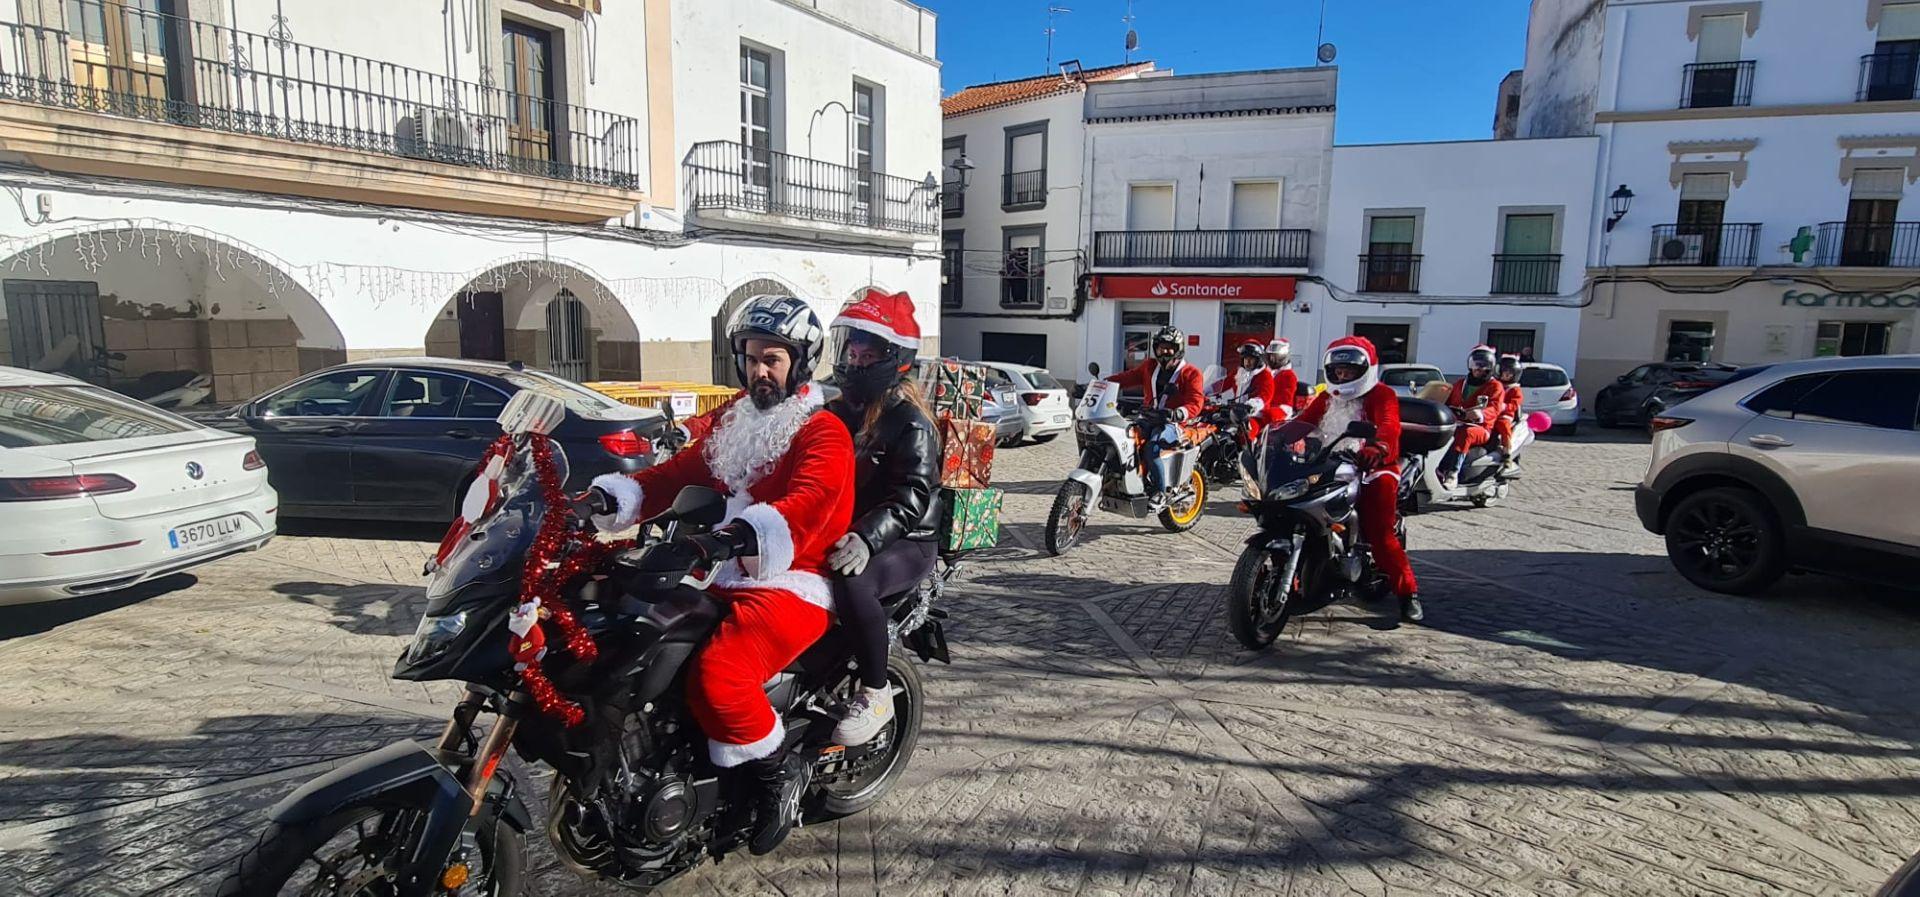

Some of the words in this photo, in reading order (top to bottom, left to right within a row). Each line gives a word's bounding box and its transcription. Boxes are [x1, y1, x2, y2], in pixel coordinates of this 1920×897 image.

[1170, 282, 1242, 296] Santander
[179, 524, 215, 544] 3670
[217, 517, 242, 535] LLM
